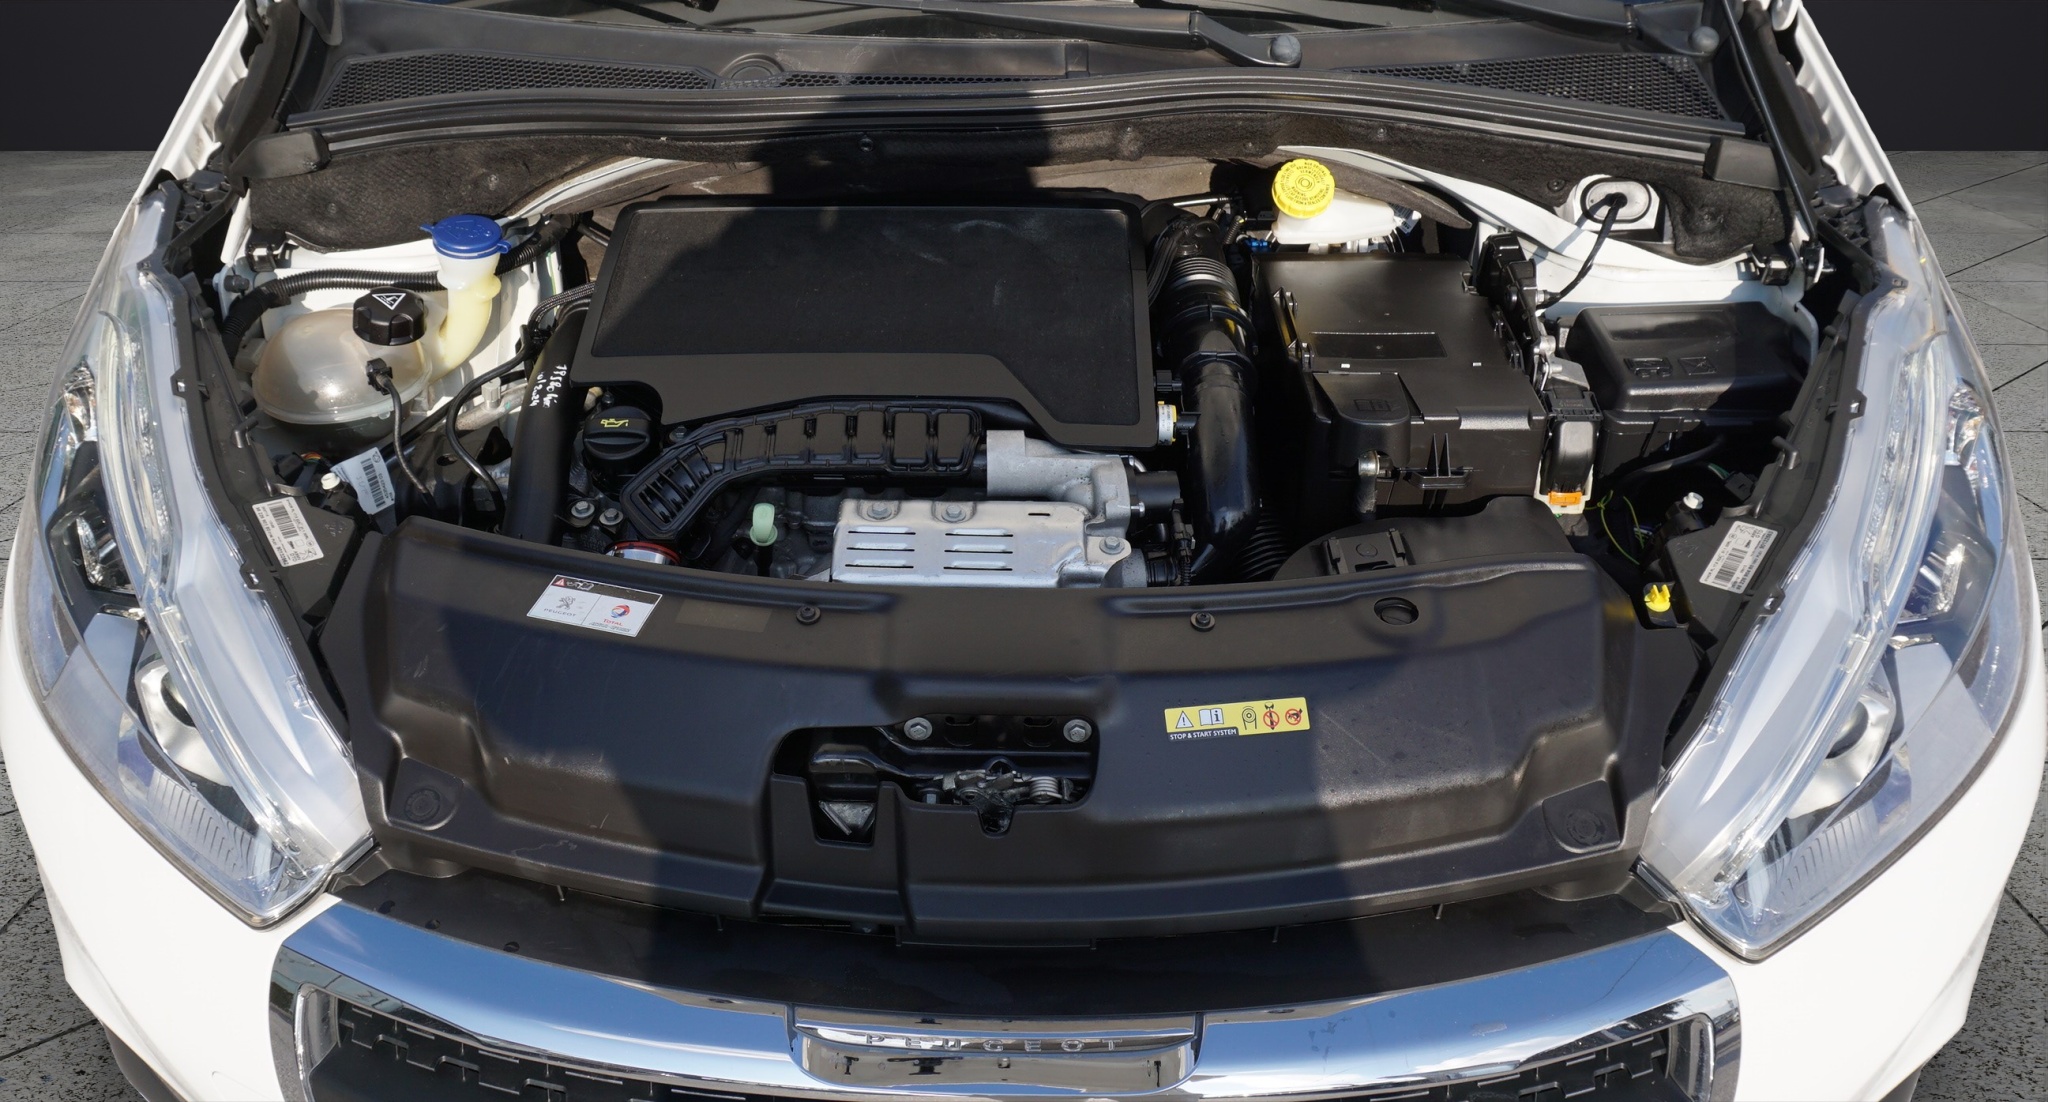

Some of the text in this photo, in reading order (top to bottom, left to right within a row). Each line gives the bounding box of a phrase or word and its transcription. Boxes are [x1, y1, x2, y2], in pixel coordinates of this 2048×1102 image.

[544, 608, 577, 617] PEUGEOT
[1169, 733, 1187, 741] STOP
[1213, 728, 1237, 737] SYSTEM
[865, 1033, 1123, 1053] PEUGEOT
